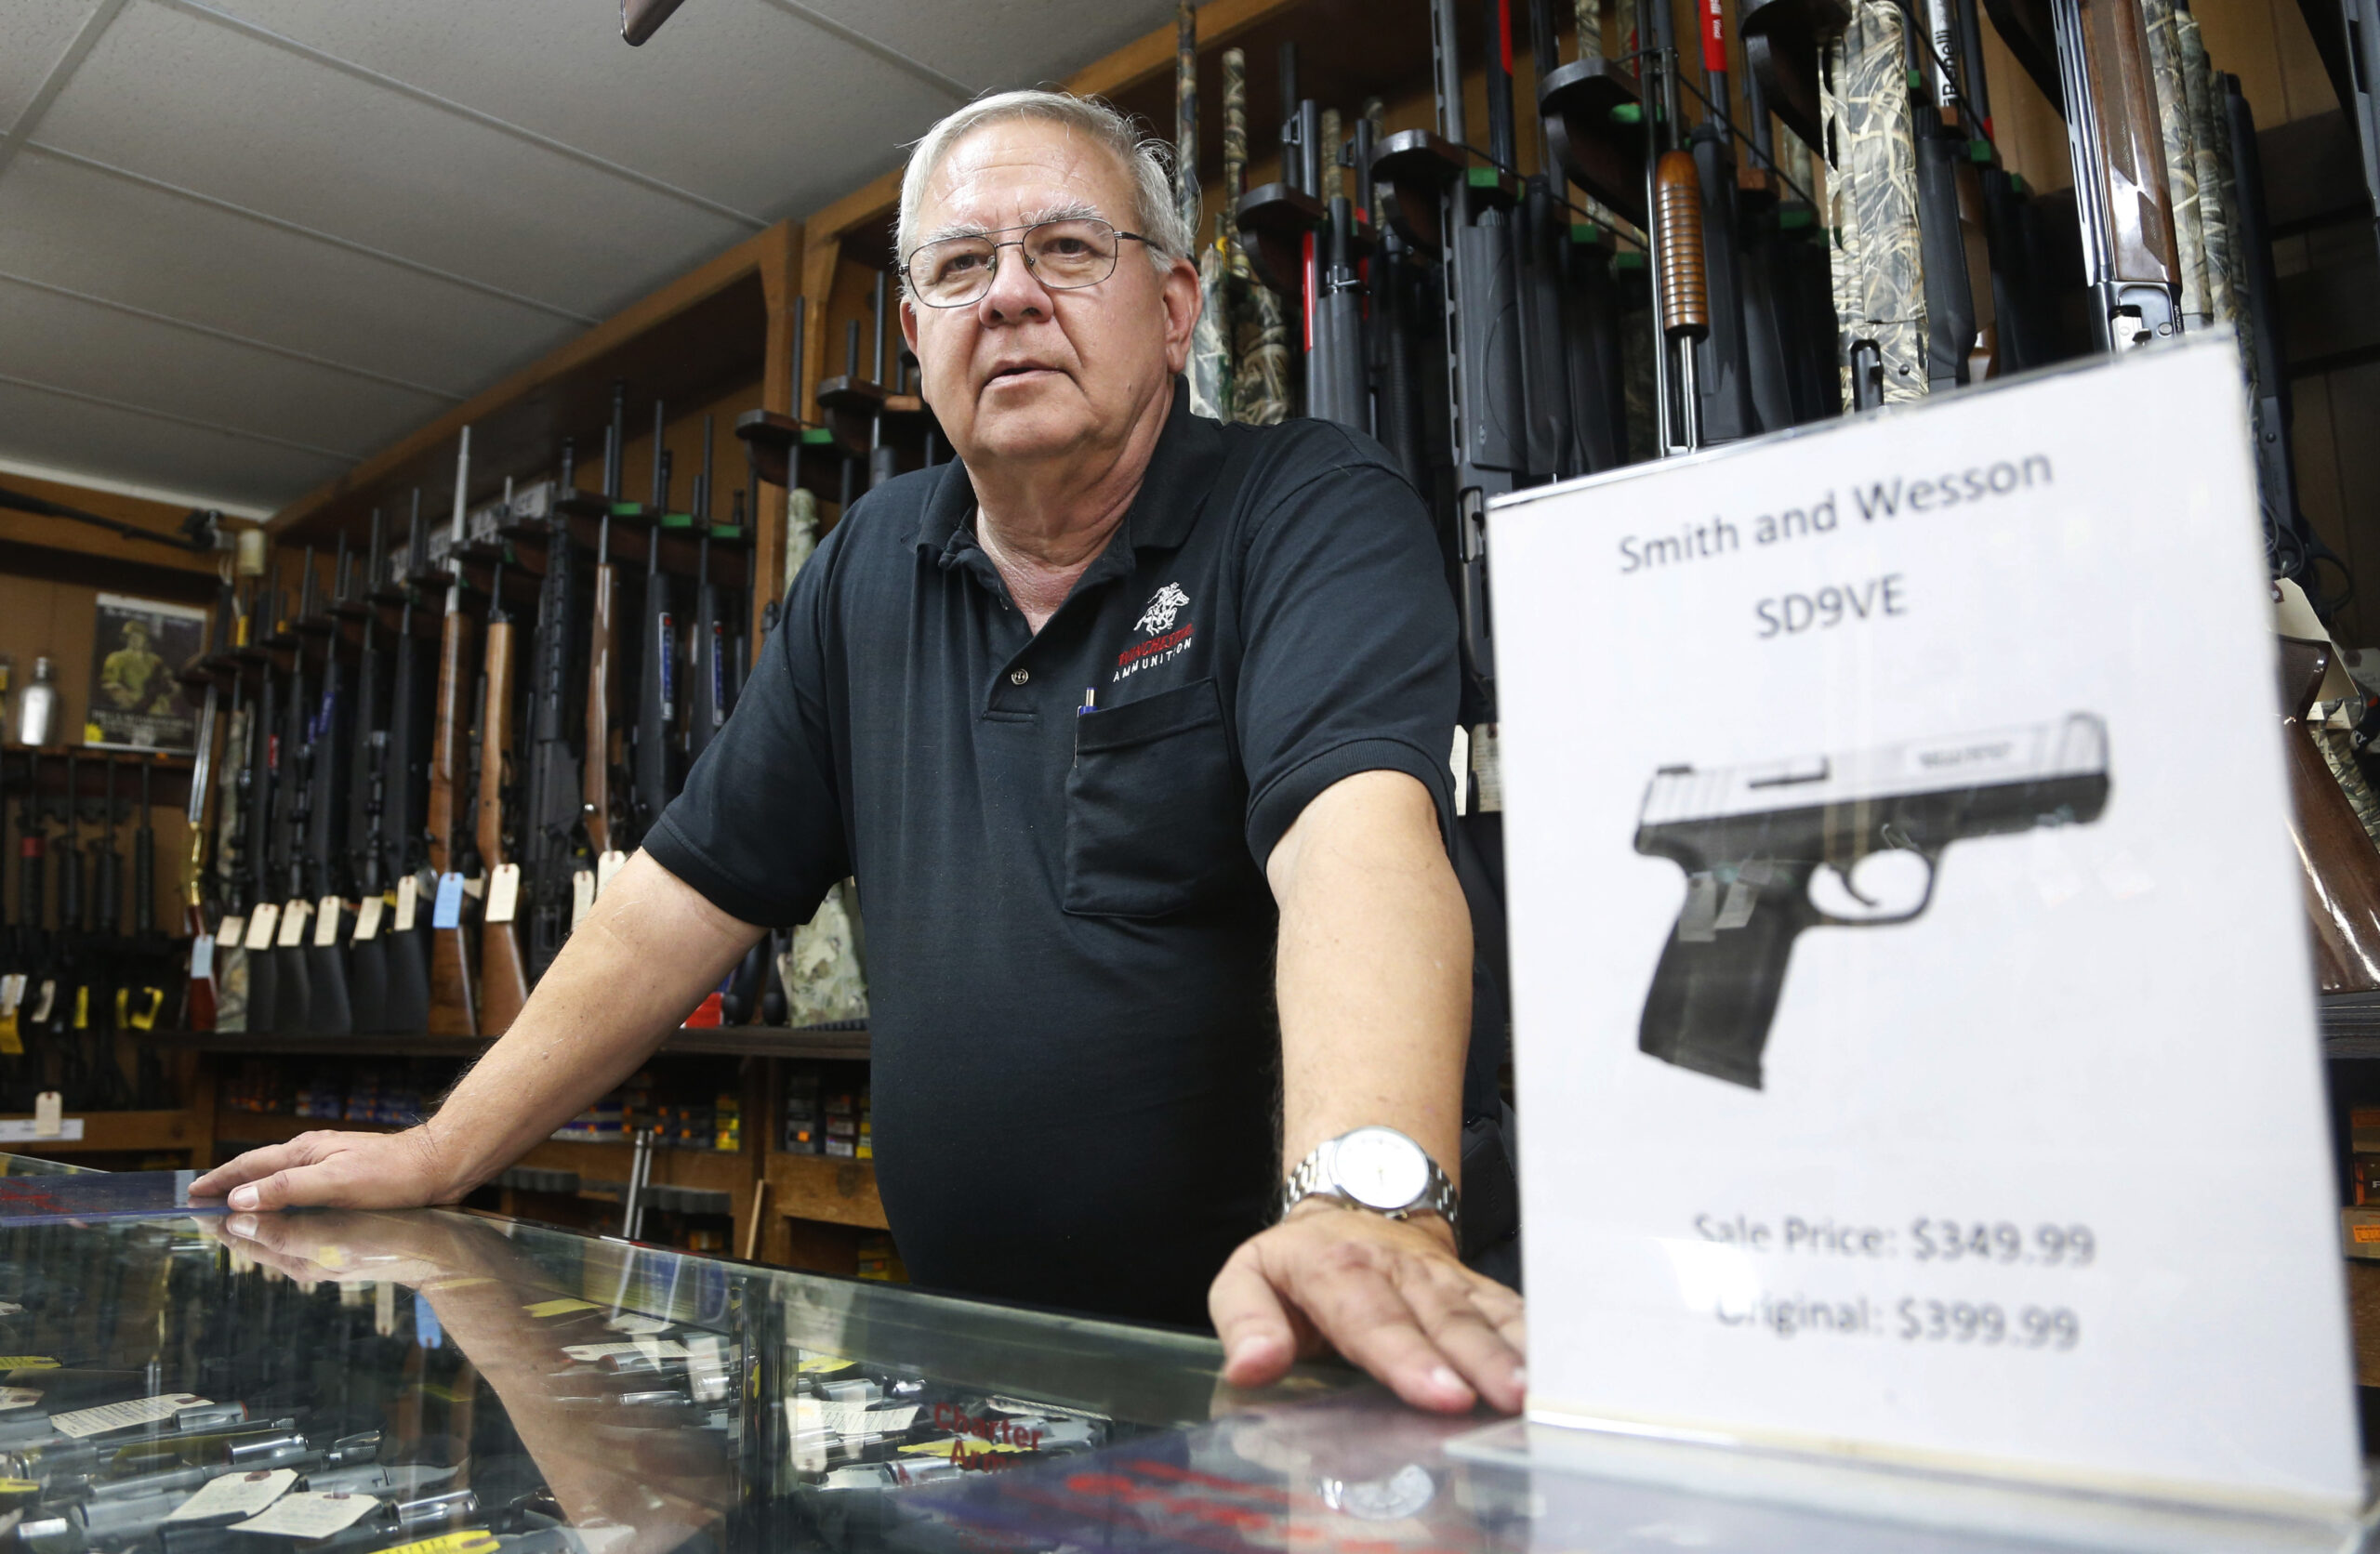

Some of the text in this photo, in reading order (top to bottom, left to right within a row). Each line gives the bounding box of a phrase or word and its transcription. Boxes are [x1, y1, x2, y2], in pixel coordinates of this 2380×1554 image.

[1935, 30, 1957, 96] Bnelli
[1618, 454, 2055, 574] Smith and Wesson
[1755, 572, 1909, 639] SD9VE
[1113, 637, 1192, 683] AMMUNITION
[1693, 1211, 2097, 1268] Sale Price: $349.99
[1715, 1291, 2082, 1352] riginal: $399.99
[933, 1402, 1044, 1451] Charter
